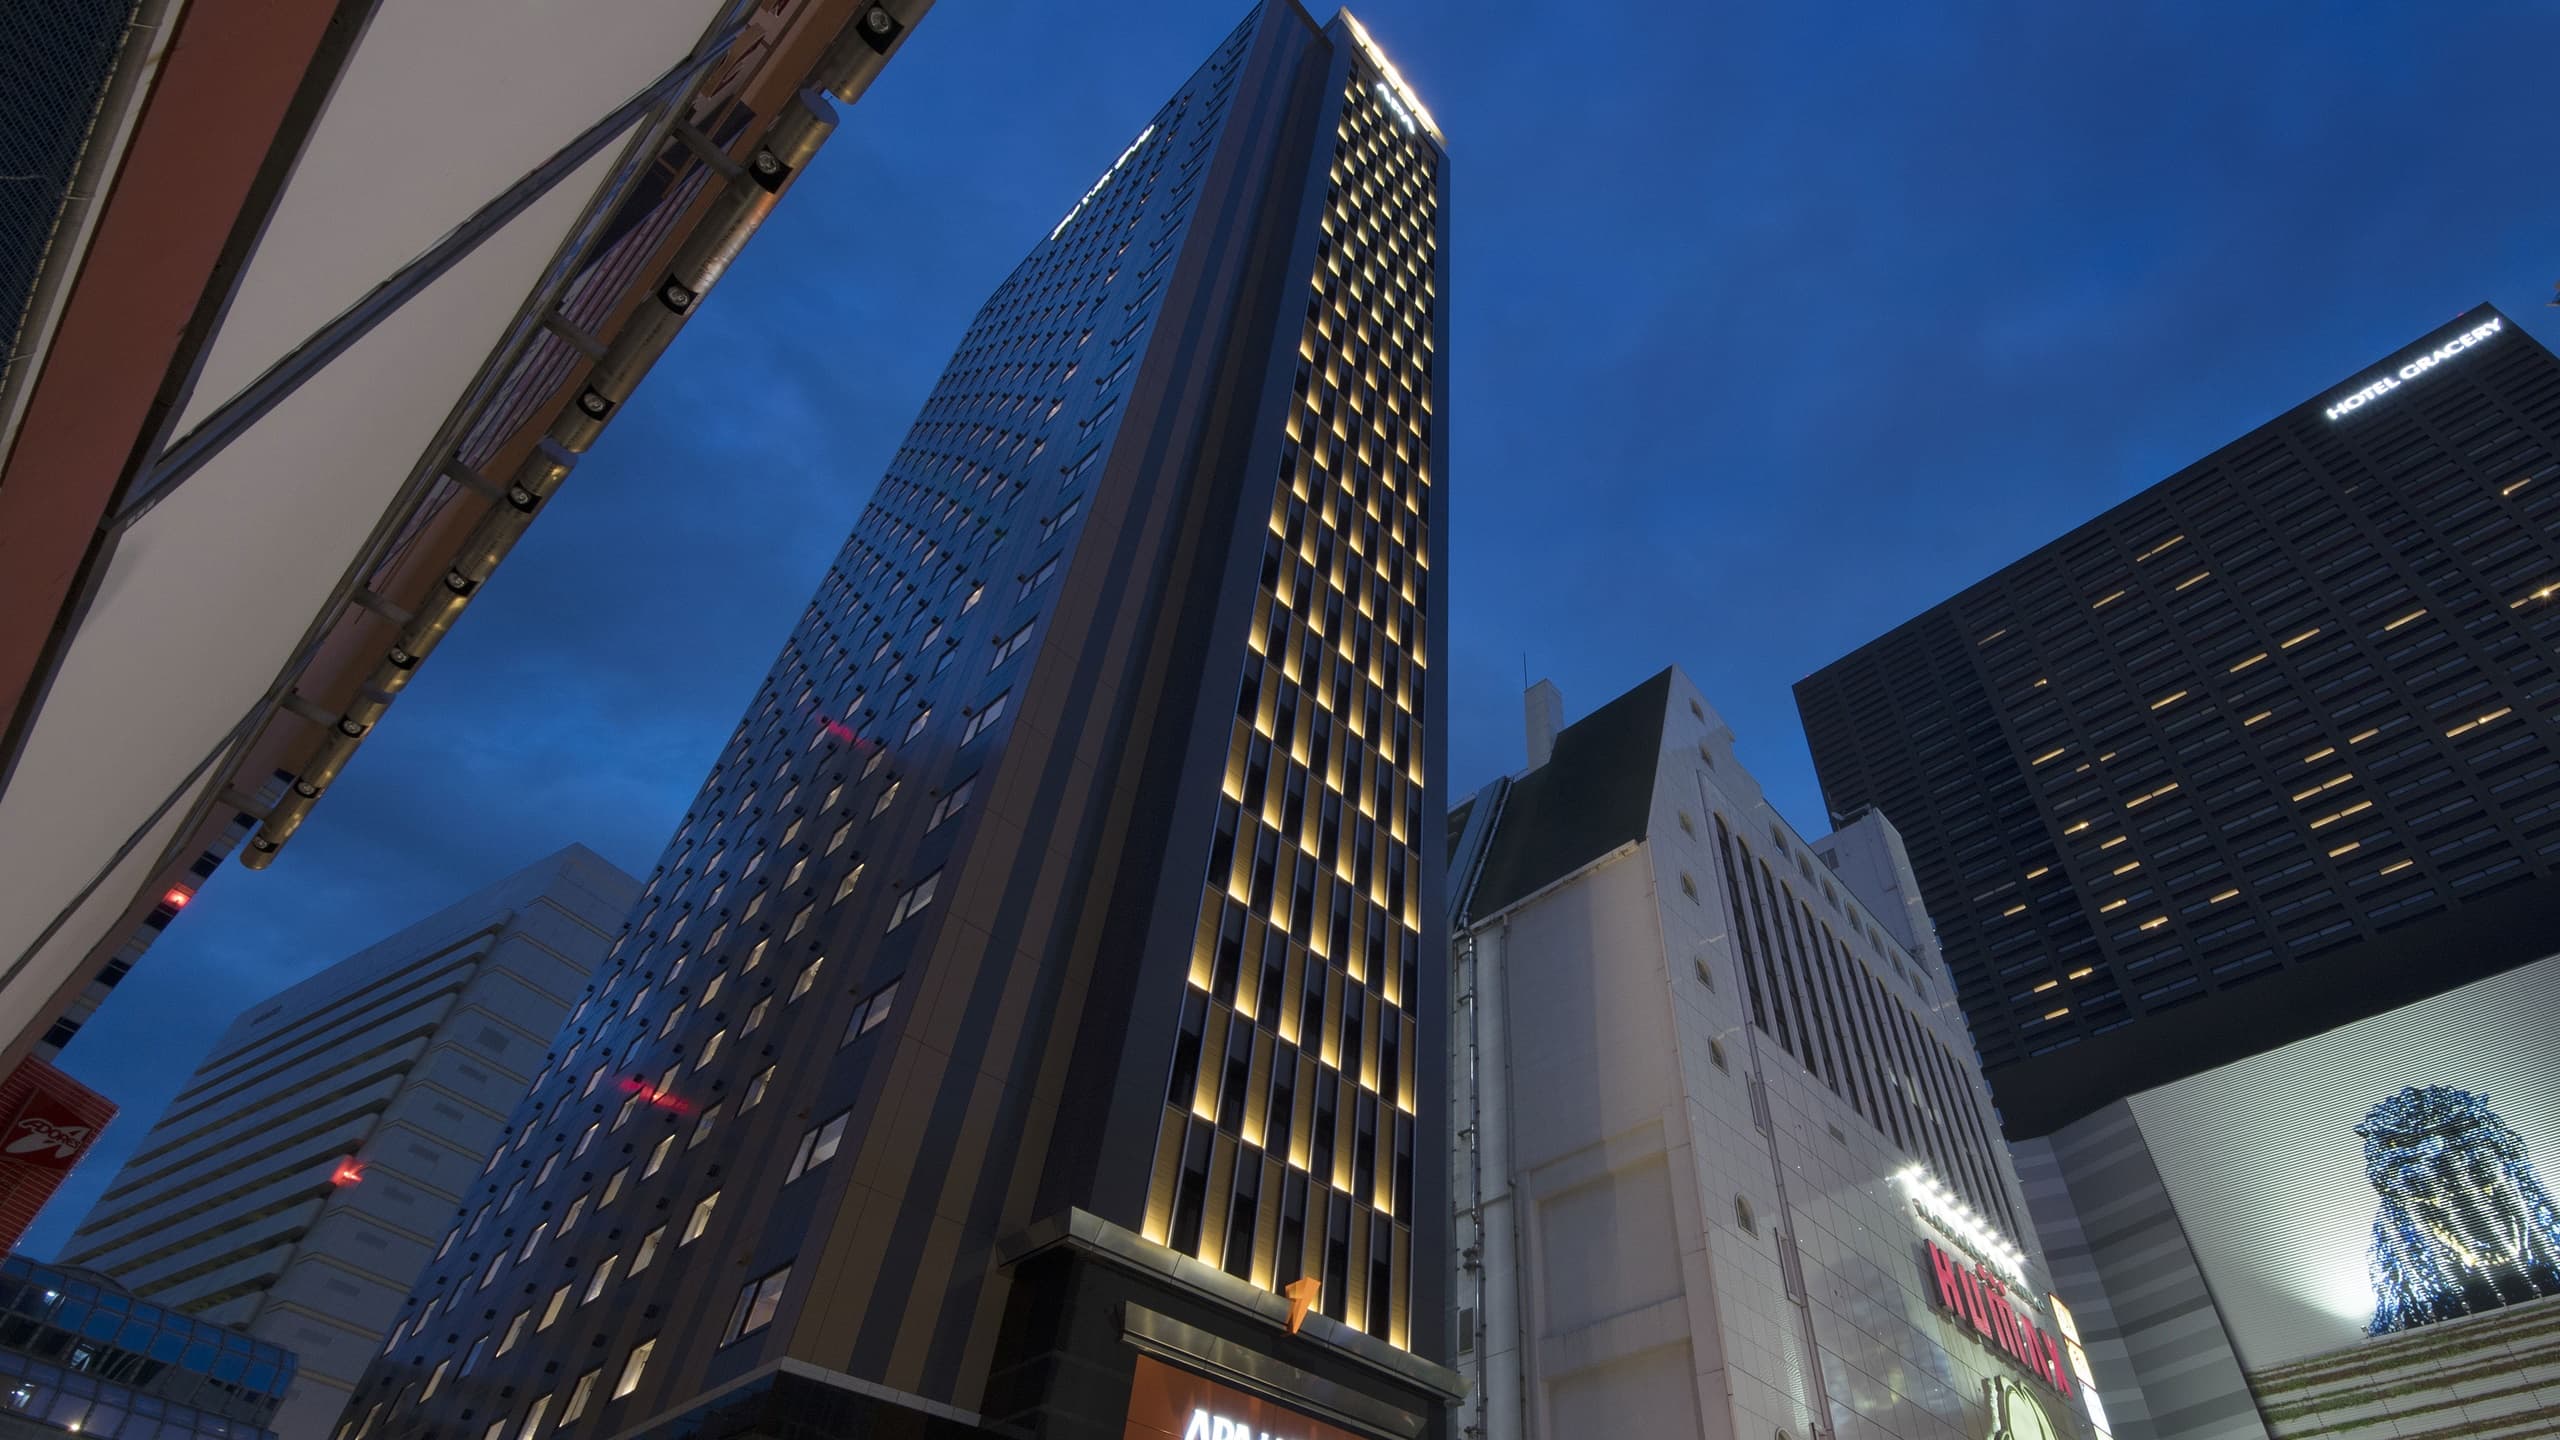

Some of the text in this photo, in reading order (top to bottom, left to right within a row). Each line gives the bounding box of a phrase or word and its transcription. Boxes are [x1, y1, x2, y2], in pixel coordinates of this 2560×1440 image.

[2326, 317, 2501, 420] HOTEL GRACERY
[1926, 1239, 2074, 1400] HUMAX
